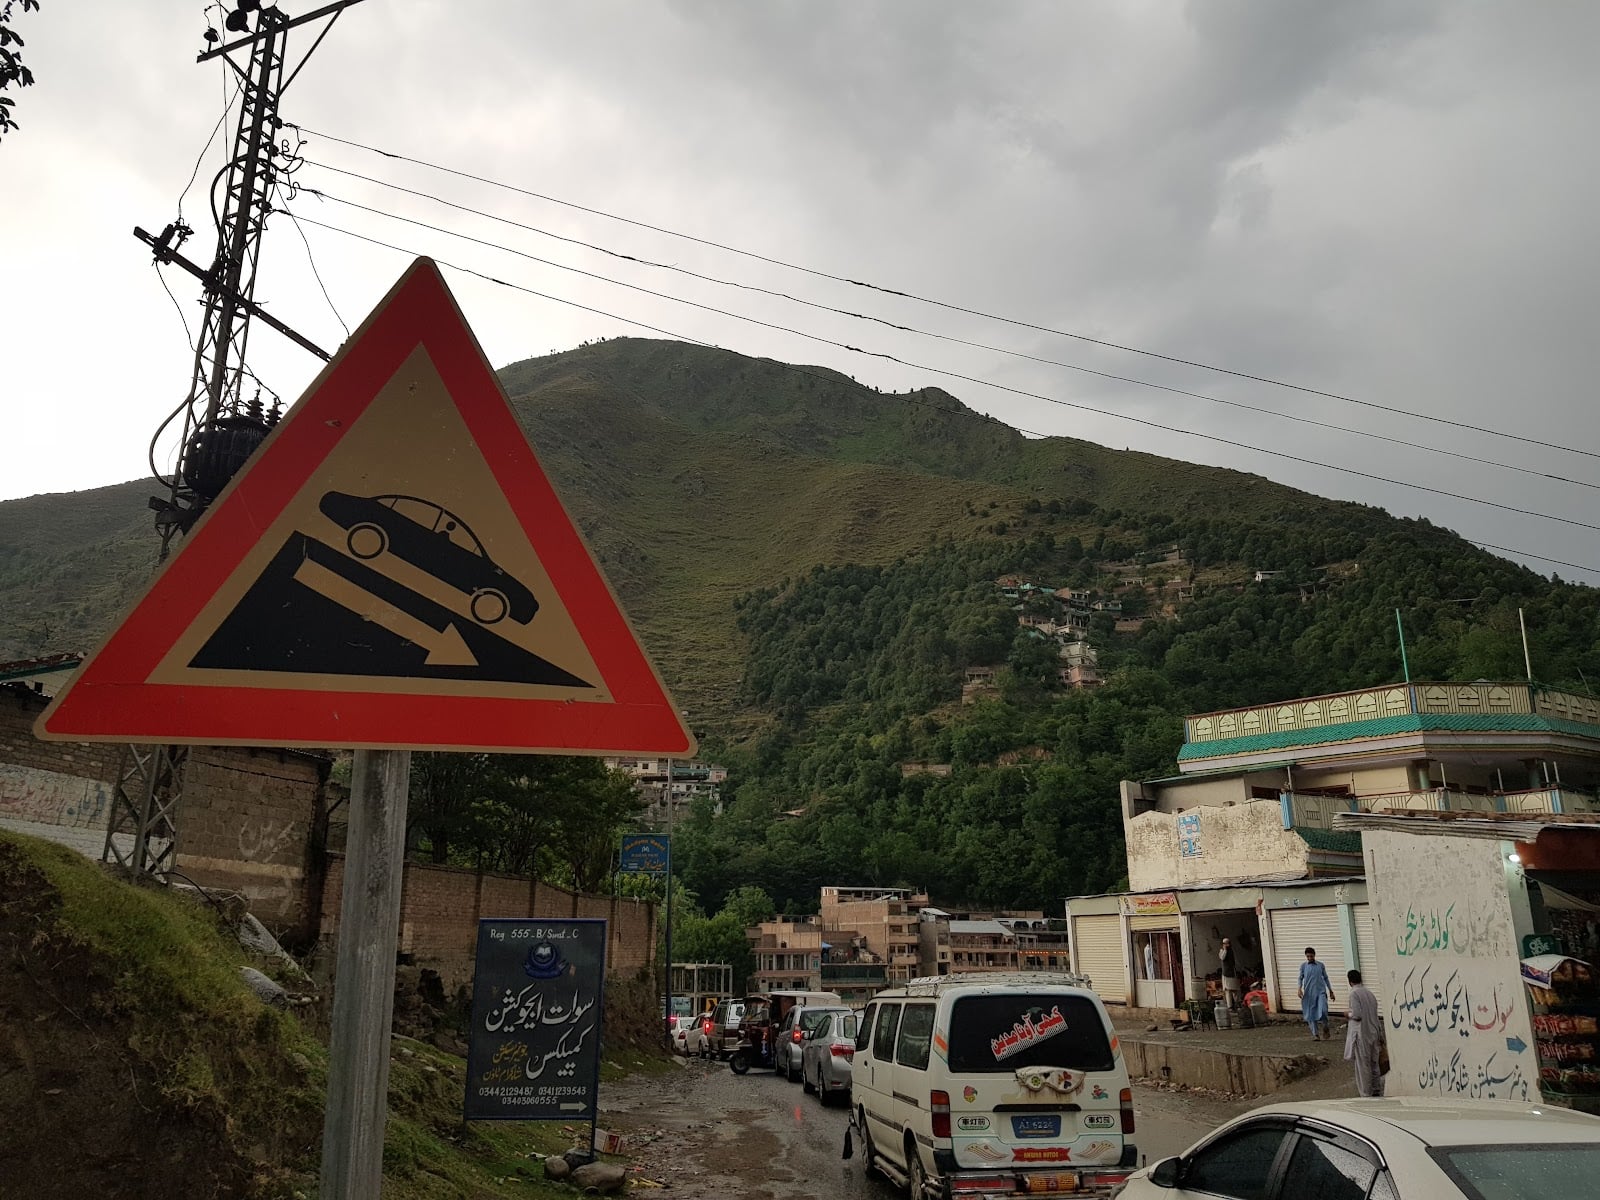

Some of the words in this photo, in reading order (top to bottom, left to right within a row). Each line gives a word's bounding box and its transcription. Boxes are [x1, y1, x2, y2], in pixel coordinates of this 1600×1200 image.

[490, 928, 504, 941] Reg
[542, 988, 595, 1024] سوات
[1472, 986, 1514, 1032] سوات
[526, 1023, 595, 1080] کمپلیکس
[479, 1087, 534, 1096] 03442129487
